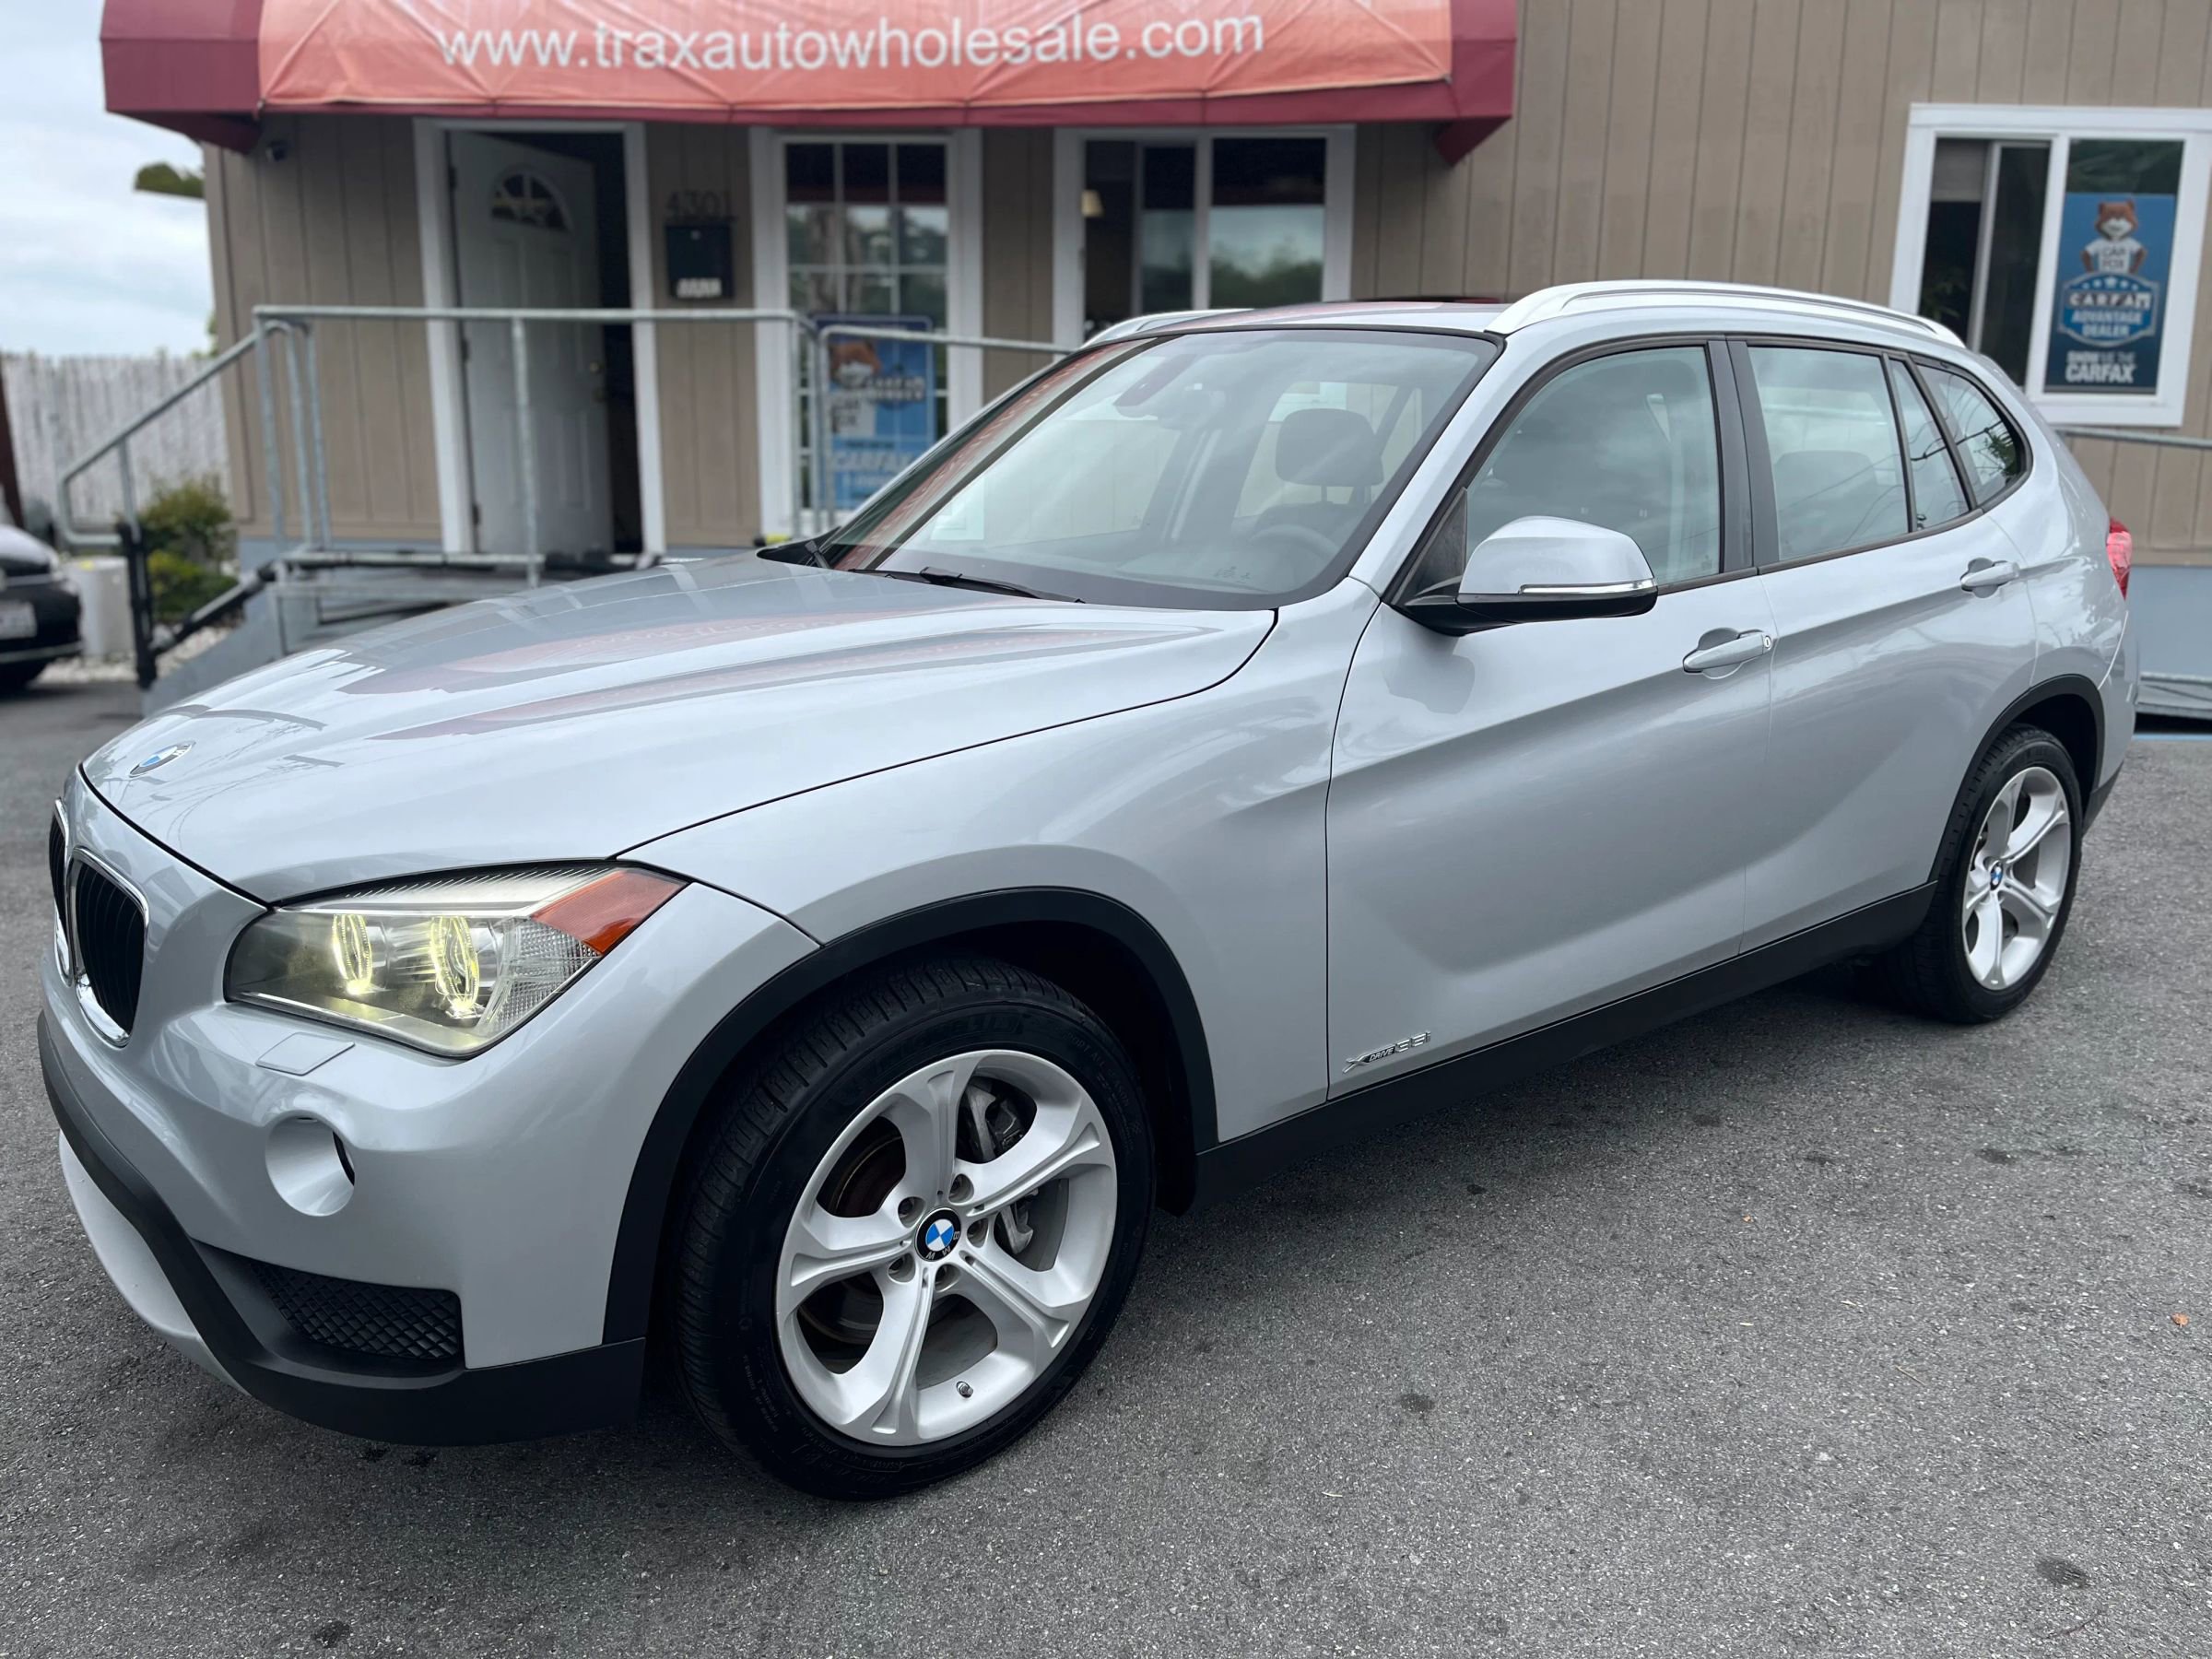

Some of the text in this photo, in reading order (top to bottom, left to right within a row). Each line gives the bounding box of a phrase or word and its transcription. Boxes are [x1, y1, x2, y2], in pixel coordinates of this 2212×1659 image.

[437, 12, 1264, 71] www.traxautowholesale.com
[2072, 311, 2142, 324] ADVANTAGE
[2081, 324, 2130, 338] DEALER
[2065, 364, 2136, 383] CARFAX
[924, 1230, 960, 1260] BMW
